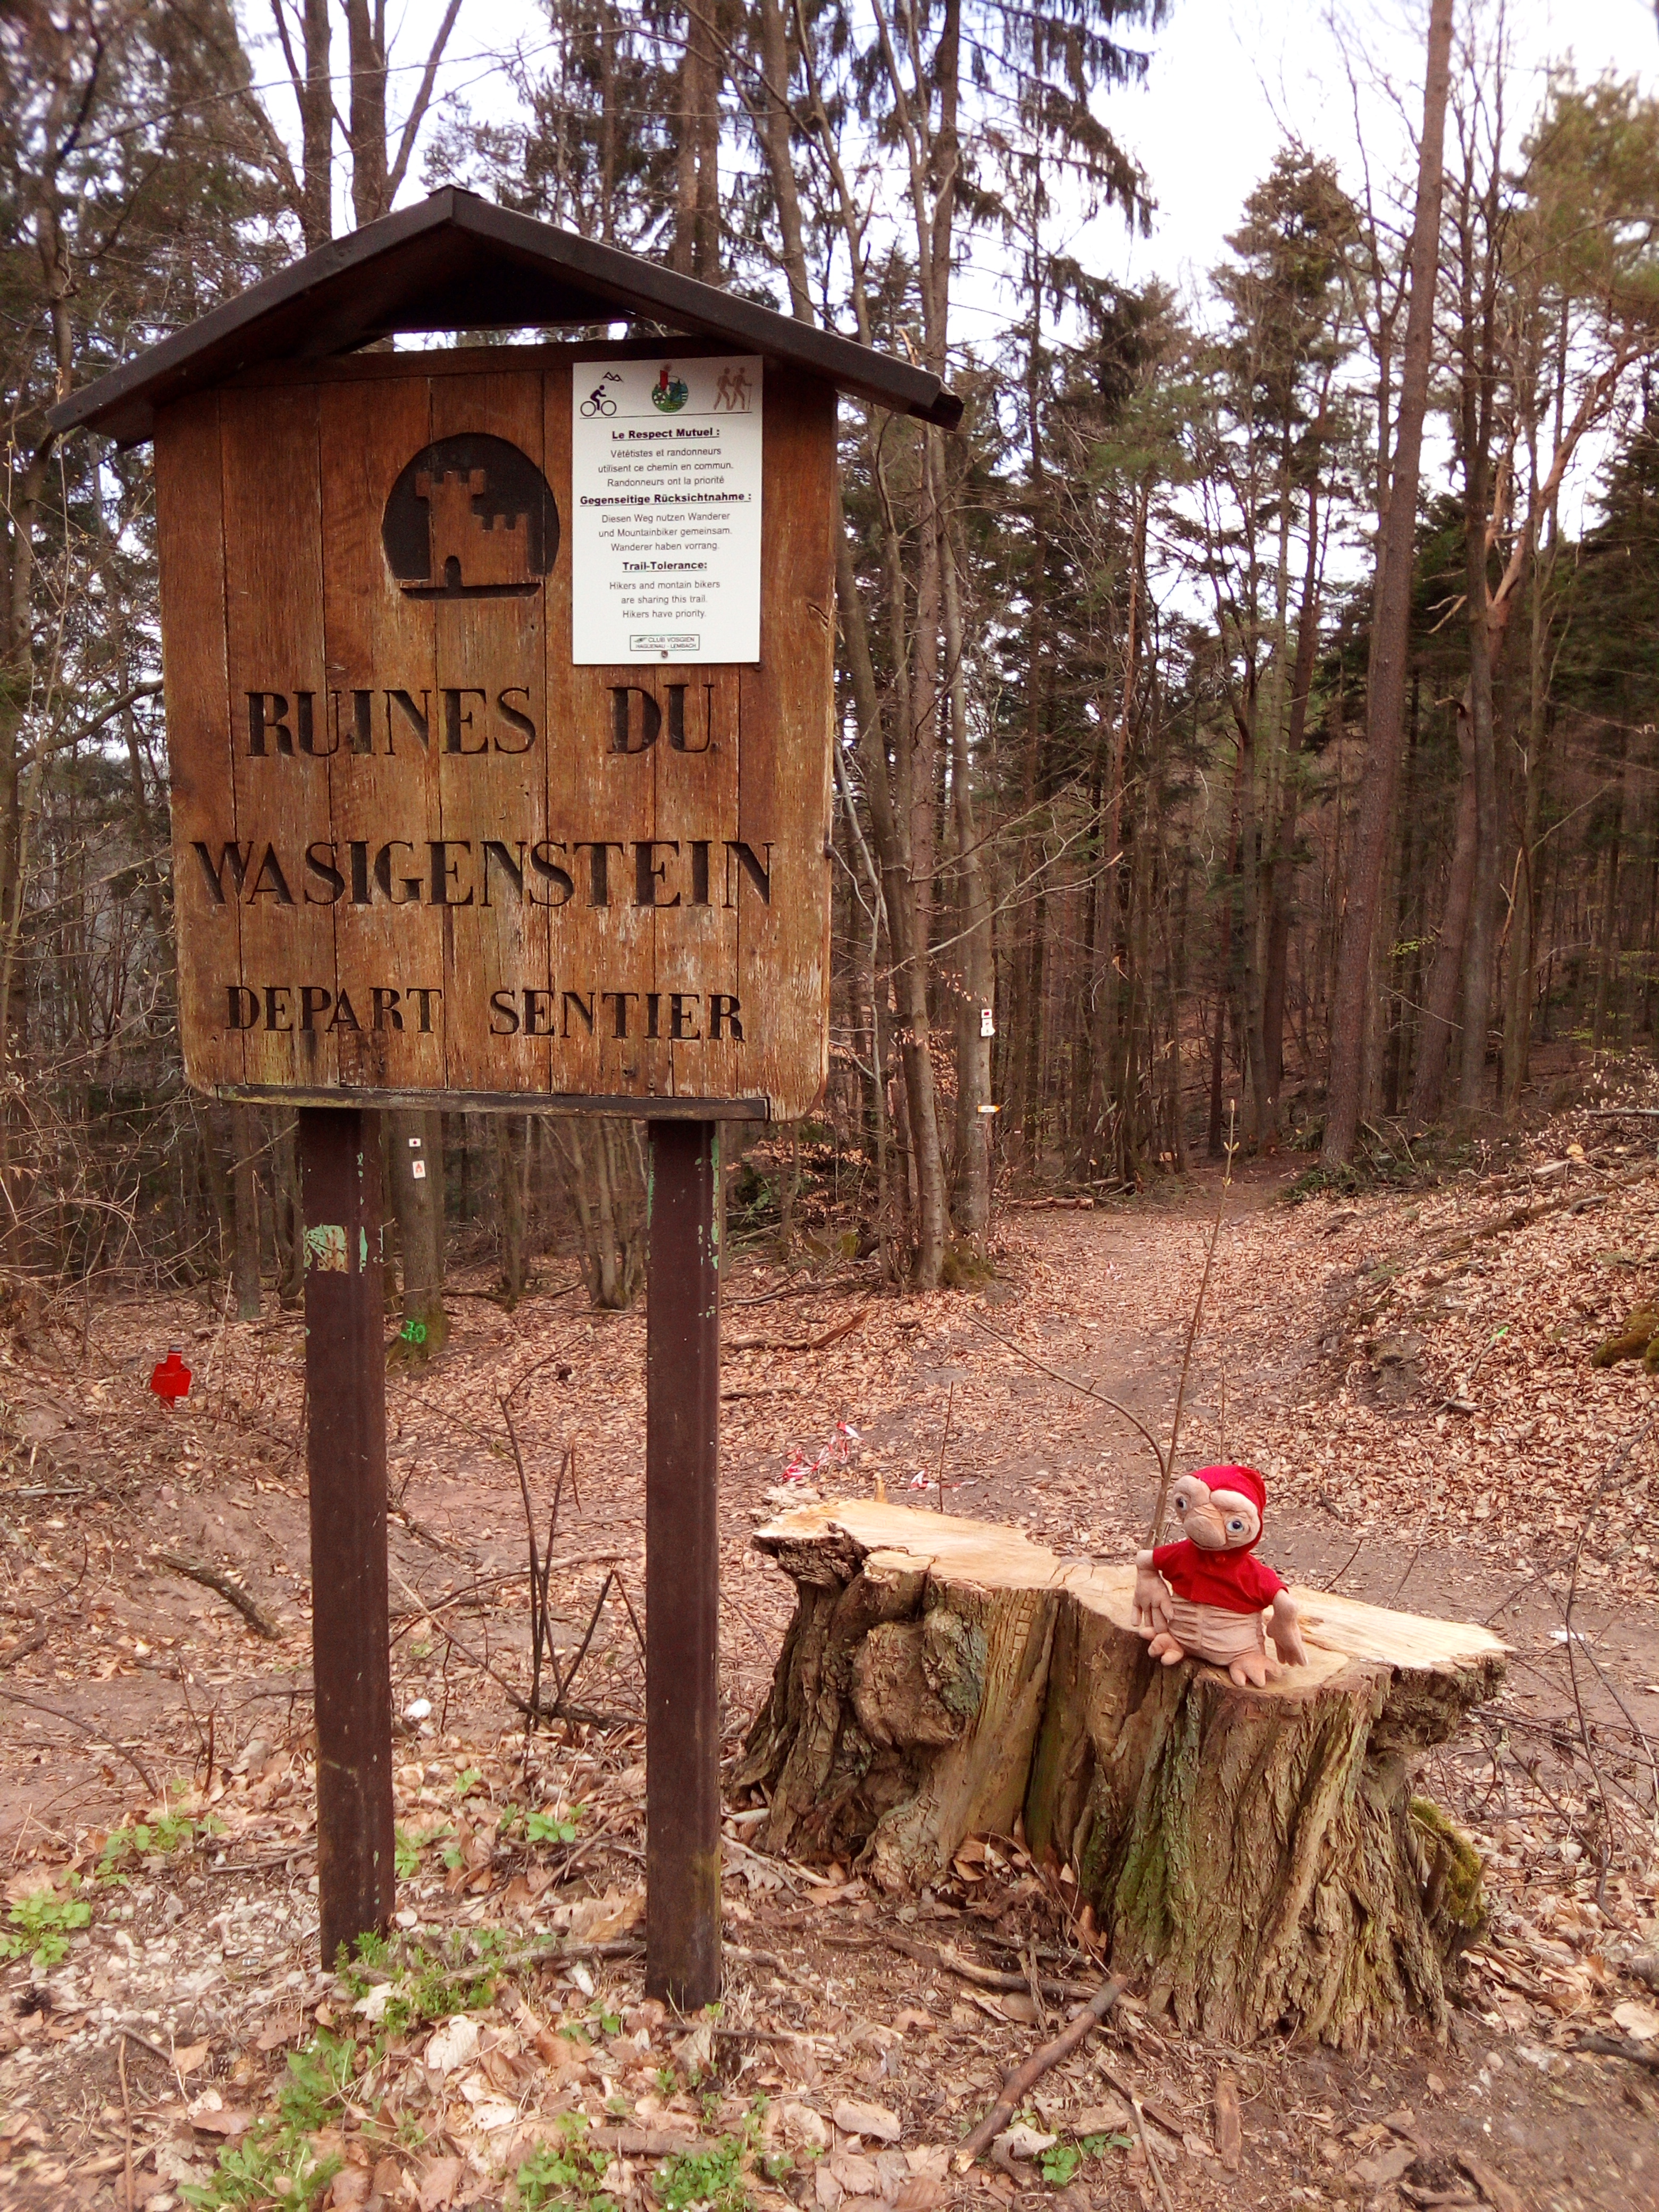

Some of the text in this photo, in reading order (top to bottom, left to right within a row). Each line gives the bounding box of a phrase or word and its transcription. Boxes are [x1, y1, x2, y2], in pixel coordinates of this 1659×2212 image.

[612, 431, 624, 439] Le
[629, 429, 673, 439] Respect
[676, 428, 713, 437] Mutuel
[611, 449, 653, 458] Vététistes
[598, 464, 631, 473] utilisent
[694, 476, 724, 486] priorité
[580, 494, 650, 505] Gegenseitige
[654, 492, 744, 503] Rücksichtnahme
[634, 514, 653, 524] Weg
[617, 528, 677, 537] Mountainbiker
[681, 527, 732, 537] gemeinsam.
[611, 543, 652, 551] Wanderer
[623, 562, 707, 571] Trail-Tolerance:
[638, 596, 668, 605] sharing
[676, 610, 706, 619] priority.
[246, 684, 716, 758] RUINES DU
[191, 840, 775, 908] WASIGENSTEIN
[224, 985, 746, 1042] DEPART SENTIER
